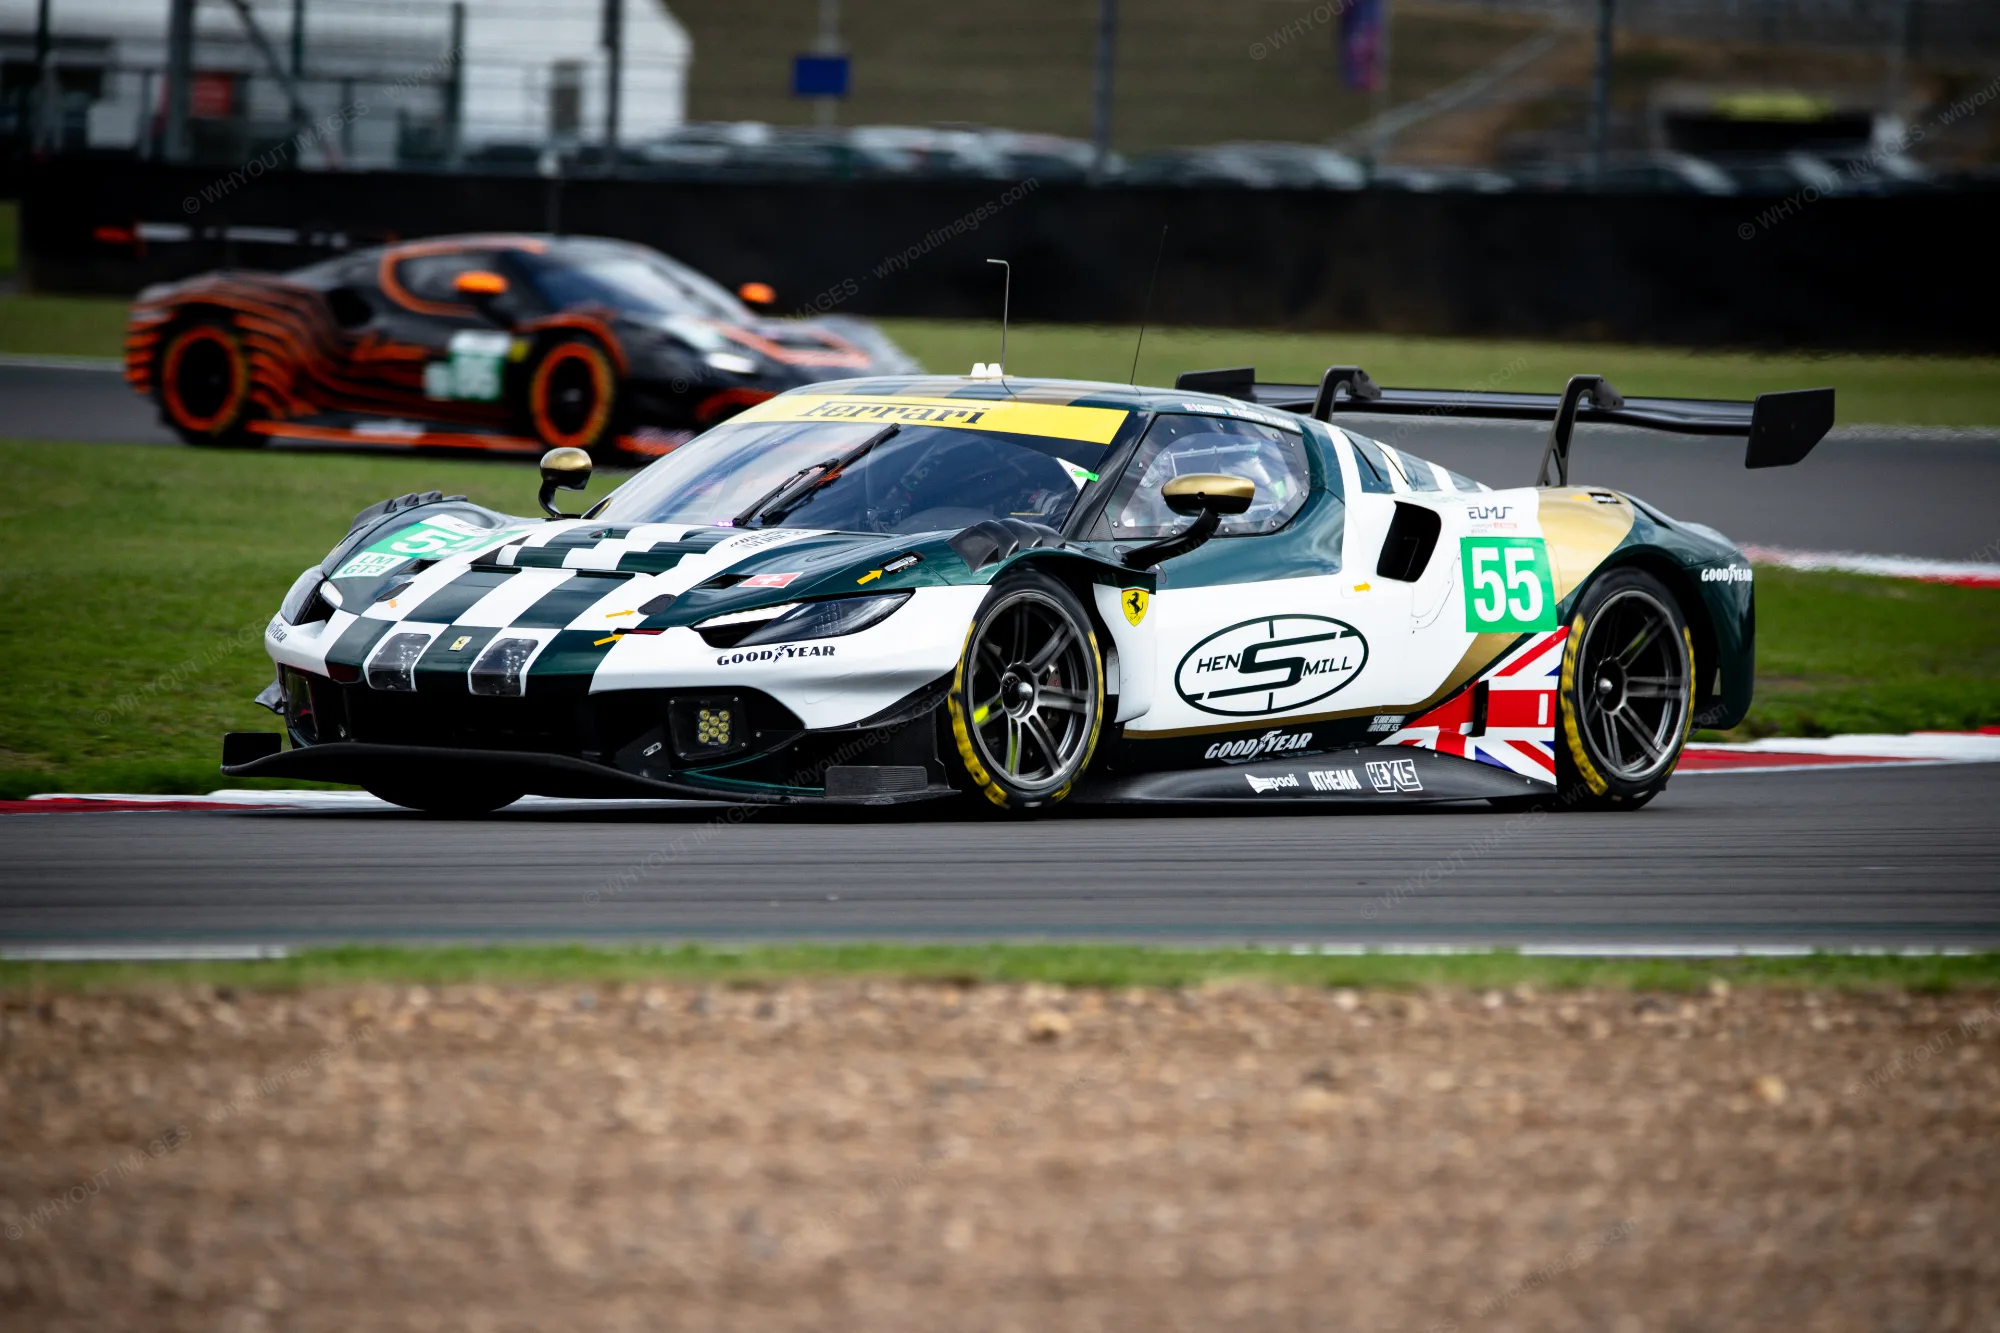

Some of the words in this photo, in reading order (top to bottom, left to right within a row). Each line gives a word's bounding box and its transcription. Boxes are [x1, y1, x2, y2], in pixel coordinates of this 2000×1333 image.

[796, 401, 991, 425] Ferrari
[344, 564, 387, 575] GT3
[358, 554, 396, 565] LM
[1471, 547, 1544, 622] 55
[1701, 564, 1752, 585] GOODYEAR
[717, 644, 836, 666] GOODYEAR
[1204, 730, 1313, 760] GOODYEAR
[1271, 774, 1299, 791] paoli
[1308, 769, 1362, 791] ATHEMA
[1366, 759, 1422, 793] HEXIS
